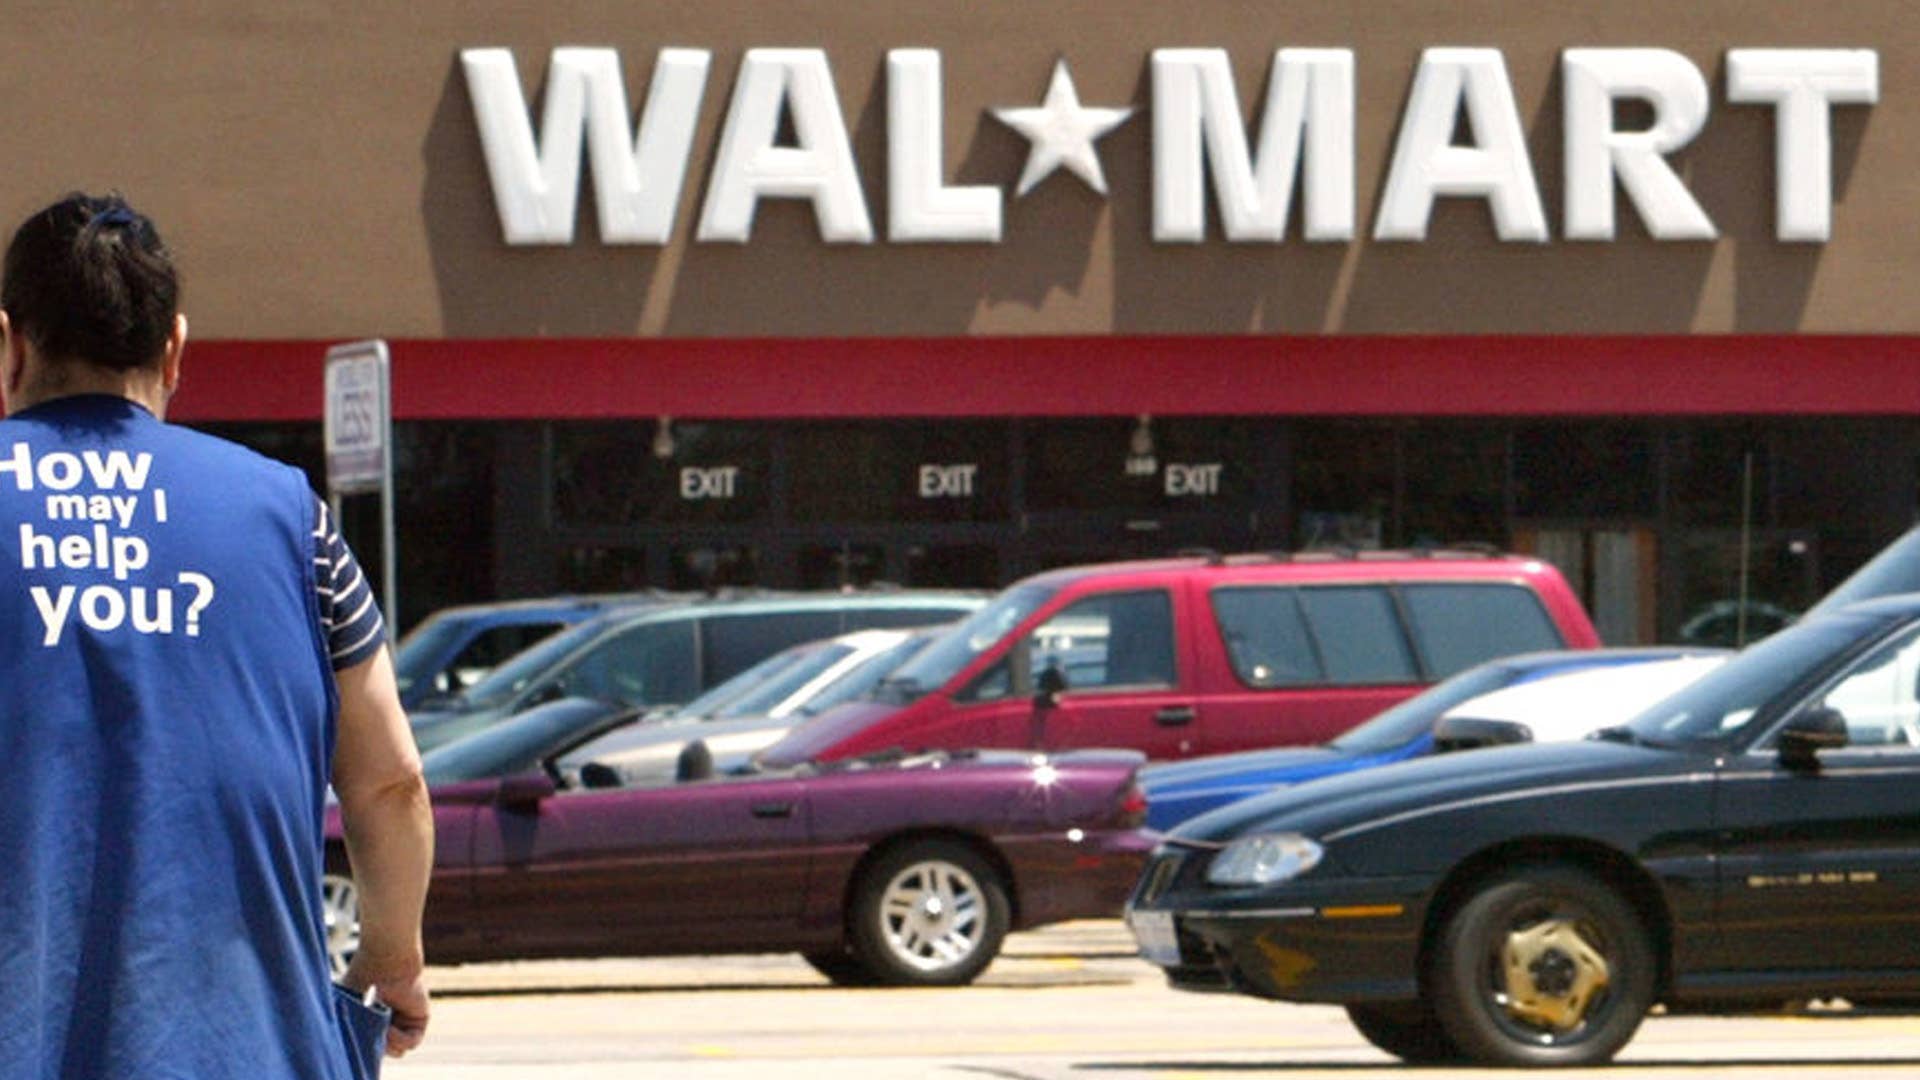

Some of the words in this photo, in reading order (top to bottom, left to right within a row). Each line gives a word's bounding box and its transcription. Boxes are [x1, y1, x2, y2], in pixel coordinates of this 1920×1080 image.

[1152, 47, 1879, 242] MART
[680, 466, 739, 499] EXIT
[919, 463, 977, 498] EXIT
[1164, 463, 1223, 497] EXIT
[46, 494, 138, 529] may
[153, 488, 167, 522] I
[19, 523, 149, 580] help
[29, 571, 214, 647] you?
